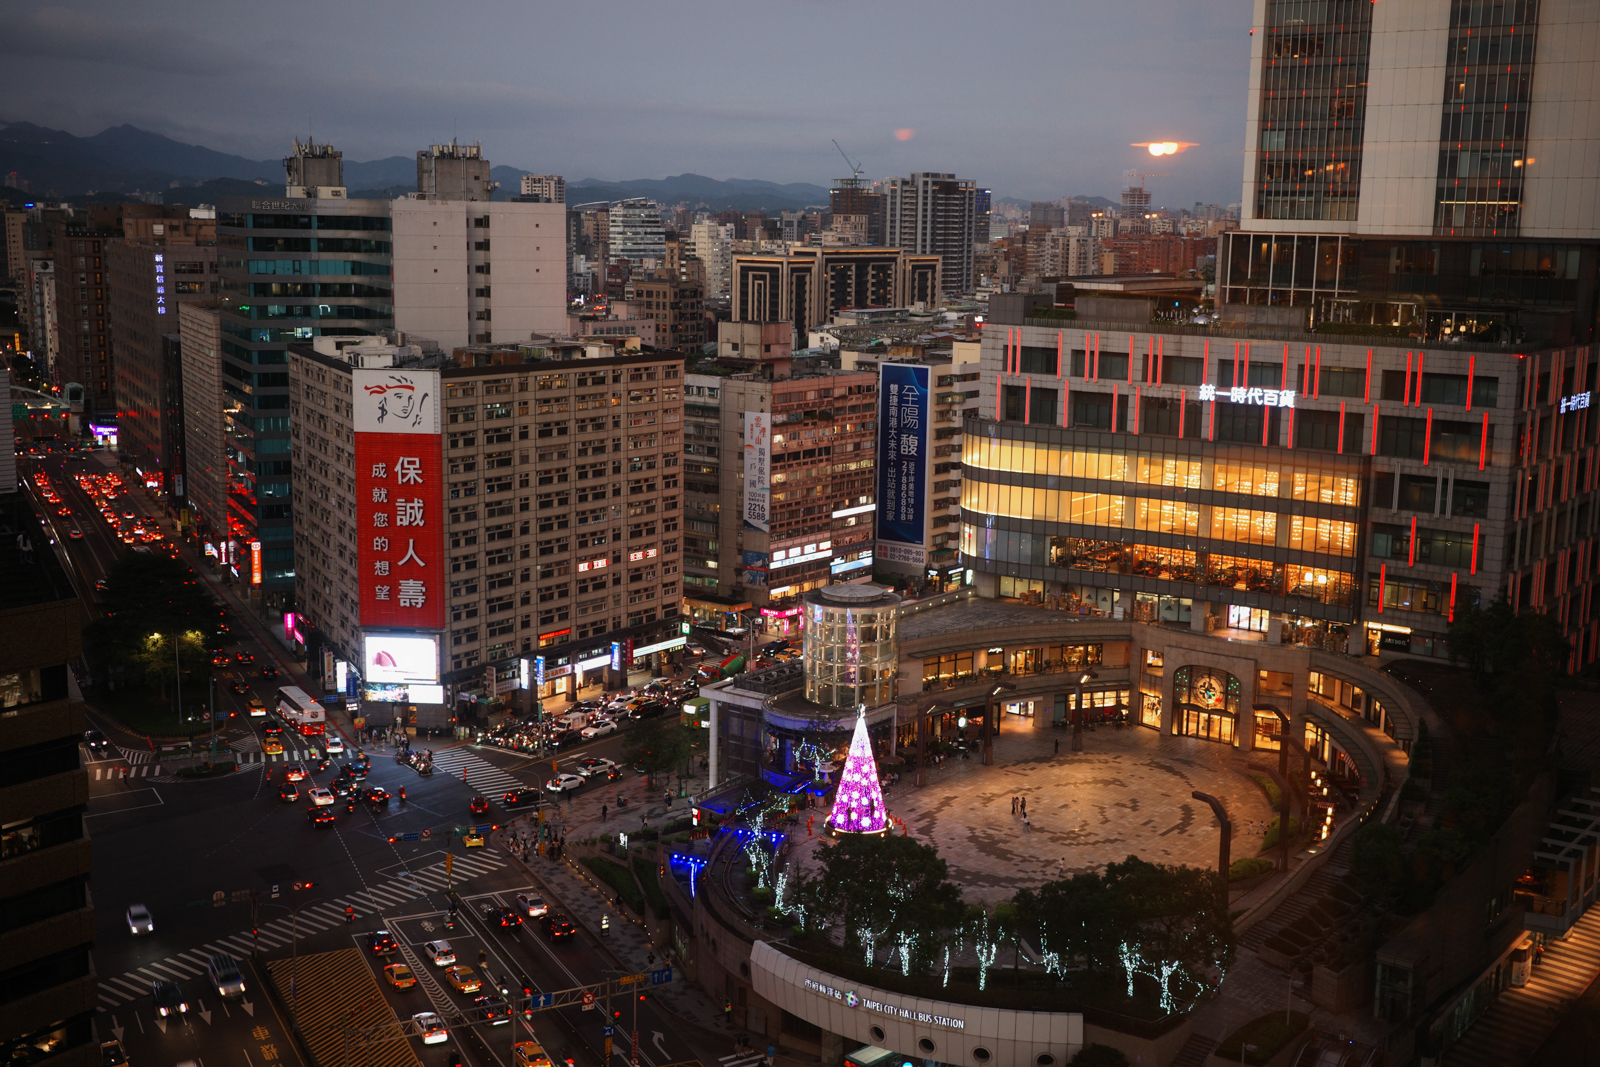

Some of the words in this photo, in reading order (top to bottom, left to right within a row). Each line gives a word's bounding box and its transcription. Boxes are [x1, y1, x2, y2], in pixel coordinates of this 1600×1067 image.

[1199, 383, 1297, 408] 統一時代百貨
[748, 502, 766, 512] 2216
[900, 460, 908, 521] 27886888
[371, 462, 391, 601] 成就您的想望
[394, 456, 427, 608] 保誠人壽
[748, 511, 766, 521] 5588
[862, 998, 883, 1012] TAIPEI
[883, 1004, 898, 1015] CITY
[899, 1008, 918, 1020] HALL
[918, 1012, 933, 1024] BUS
[933, 1015, 964, 1029] STATION
[251, 1025, 284, 1067] 機車
